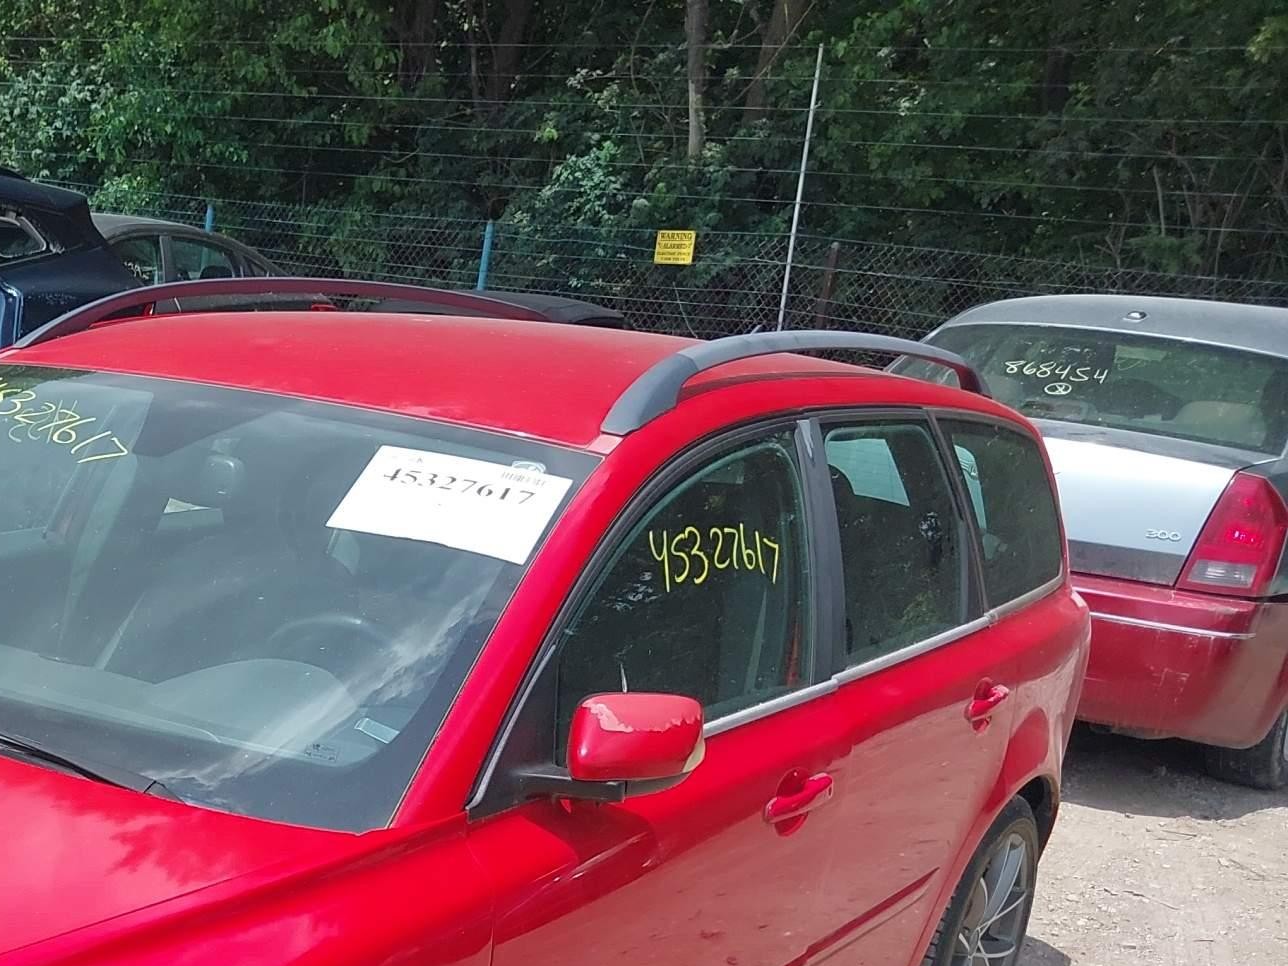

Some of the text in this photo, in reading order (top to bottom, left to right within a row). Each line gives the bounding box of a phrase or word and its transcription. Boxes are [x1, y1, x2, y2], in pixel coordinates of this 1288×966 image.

[1004, 360, 1109, 384] 868454
[383, 468, 537, 504] 45327617
[1145, 529, 1182, 542] 300
[649, 522, 779, 593] 45327617
